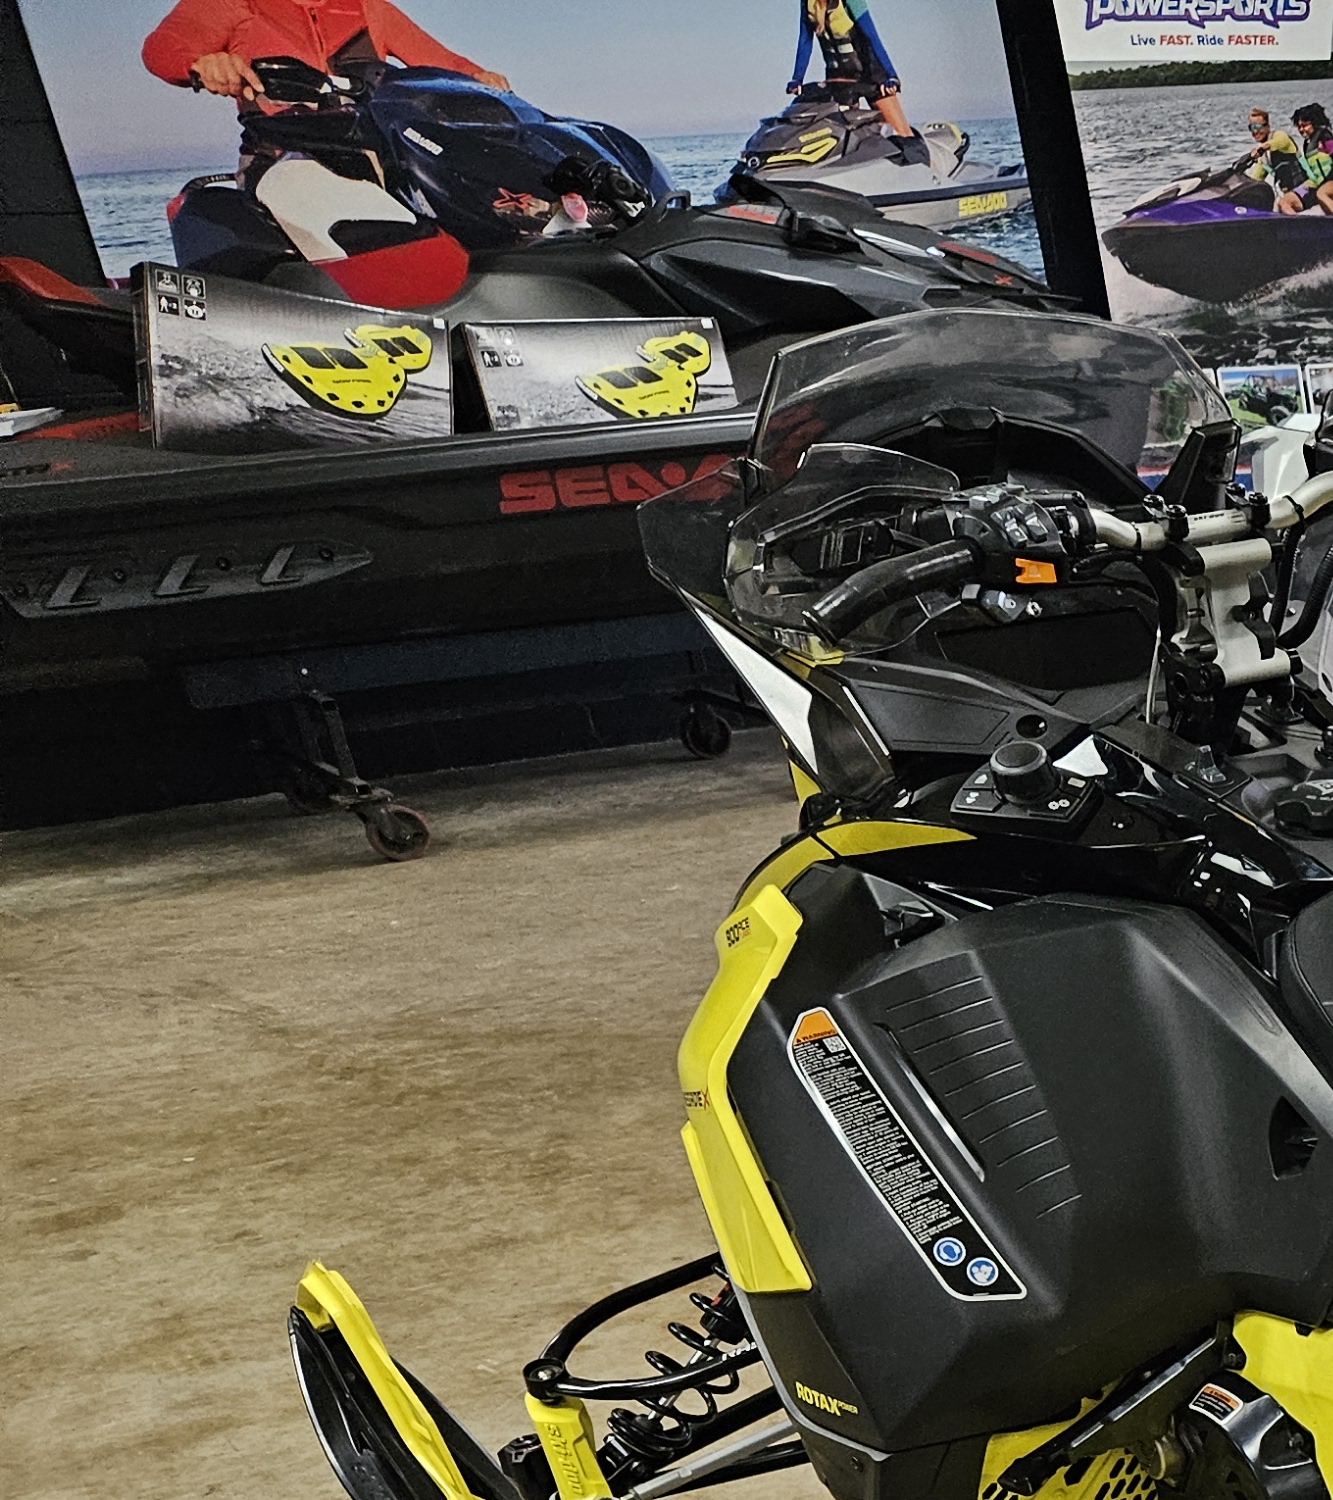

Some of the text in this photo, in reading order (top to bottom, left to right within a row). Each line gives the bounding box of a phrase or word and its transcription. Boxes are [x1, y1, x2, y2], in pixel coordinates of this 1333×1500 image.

[1131, 34, 1279, 46] Live FAST. Ride FASTER.
[795, 1381, 841, 1416] ROTAX
